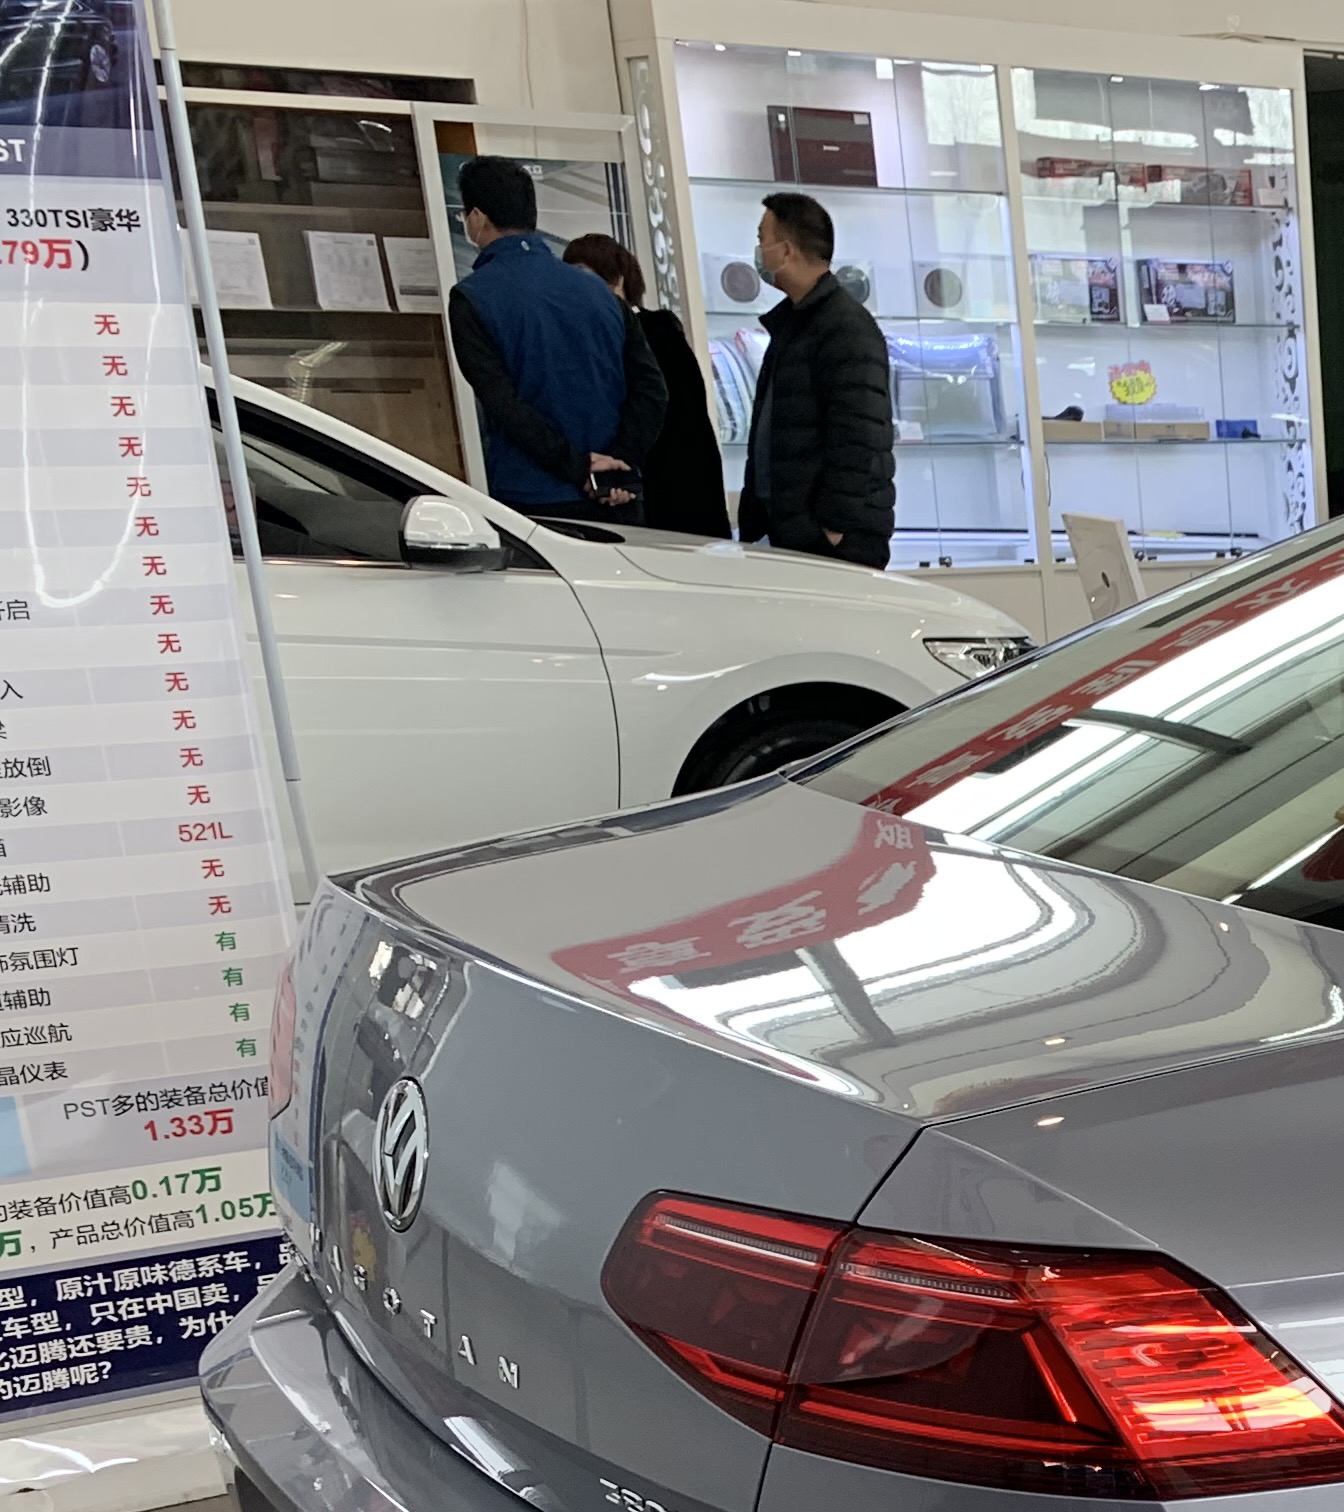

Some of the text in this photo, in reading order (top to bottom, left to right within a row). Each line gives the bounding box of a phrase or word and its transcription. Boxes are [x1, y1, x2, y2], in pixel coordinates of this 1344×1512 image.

[6, 207, 141, 233] 330TSI豪华
[95, 314, 120, 335] 无
[102, 355, 128, 377] 无
[110, 396, 136, 417] 无
[118, 437, 143, 457] 无
[126, 477, 152, 498] 无
[134, 516, 159, 537] 无
[142, 556, 167, 576] 无
[0, 595, 175, 620] 启 无
[157, 633, 182, 654] 无
[164, 672, 189, 692] 无
[172, 710, 197, 730] 无
[0, 748, 204, 779] 放倒 无
[187, 785, 211, 805] 无
[178, 822, 233, 842] 521L
[0, 858, 225, 896] 辅助 无
[208, 896, 232, 916] 无
[215, 931, 237, 951] 有
[0, 967, 243, 1011] 辅助 有
[229, 1003, 250, 1022] 有
[236, 1038, 257, 1058] 有
[63, 1076, 269, 1120] PST多的装备总价值
[143, 1108, 235, 1141] 1.33万
